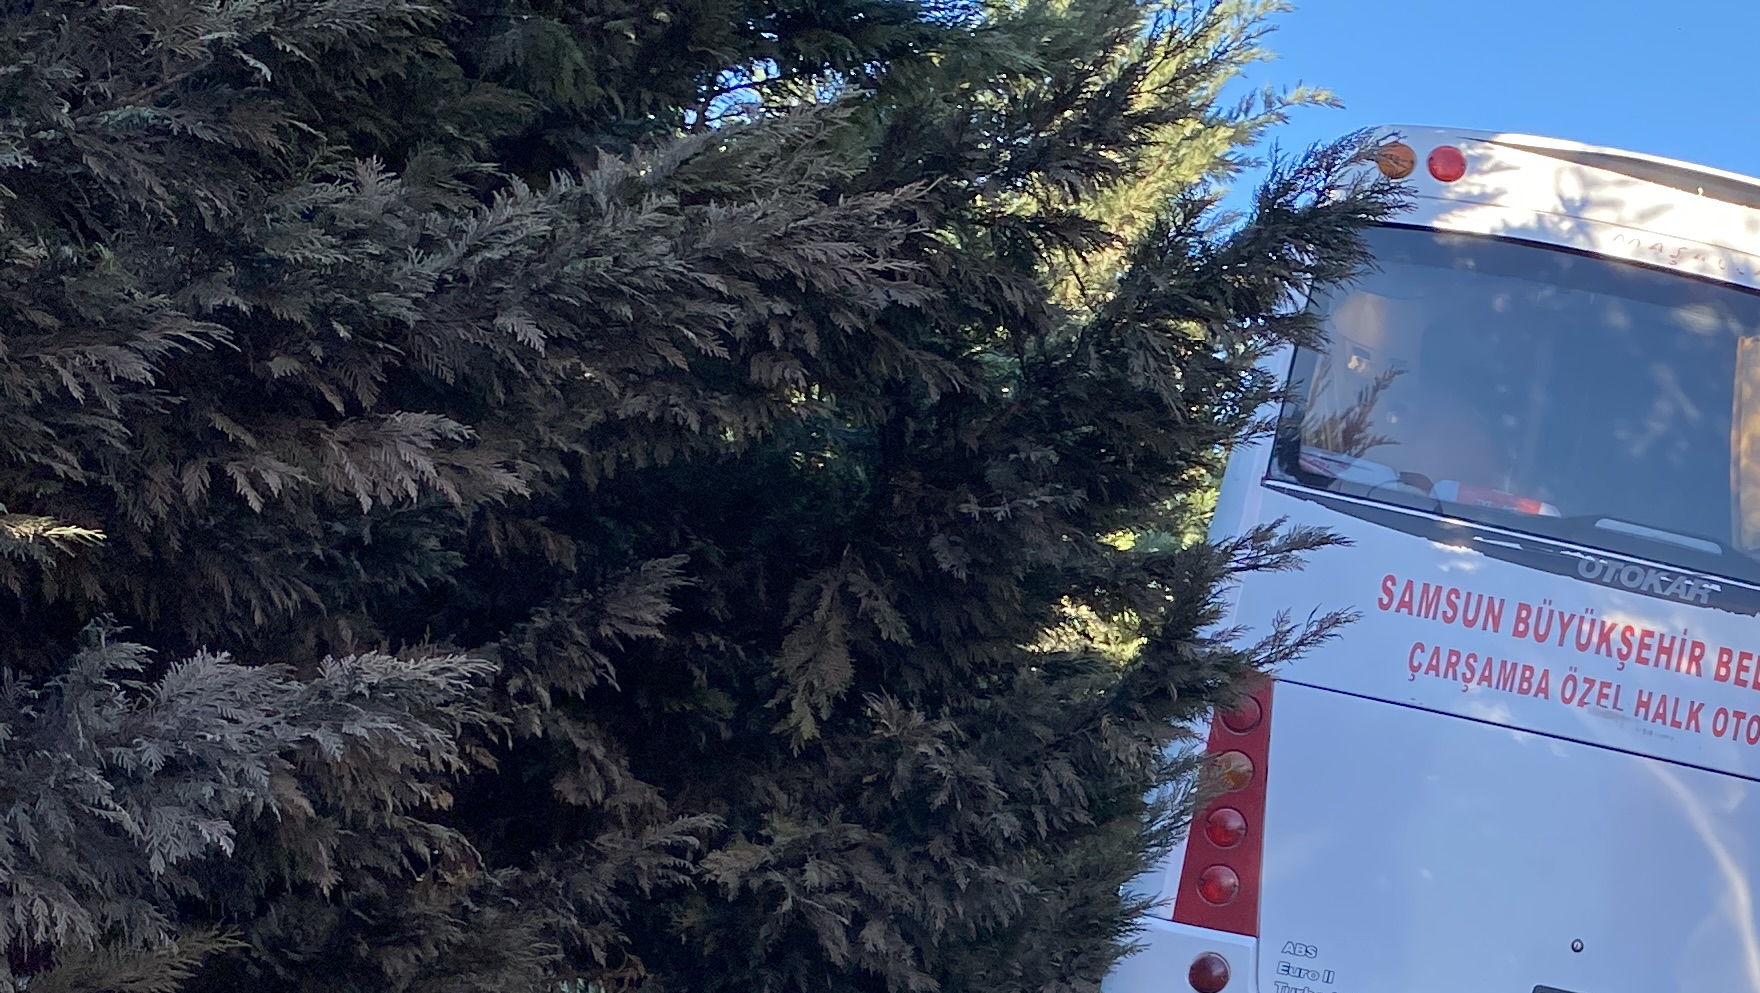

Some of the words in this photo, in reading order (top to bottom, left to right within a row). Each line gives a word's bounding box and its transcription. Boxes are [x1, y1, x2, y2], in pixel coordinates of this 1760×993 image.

[1577, 558, 1713, 604] OTOKAR
[1377, 574, 1505, 633] SAMSUN
[1511, 598, 1706, 678] BÜYÜKŞEHİR
[1407, 641, 1550, 700] ÇARŞAMBA
[1560, 665, 1624, 712] ÖZEL
[1633, 689, 1706, 734] HALK
[1276, 961, 1320, 982] Euro
[1281, 941, 1318, 959] ABS
